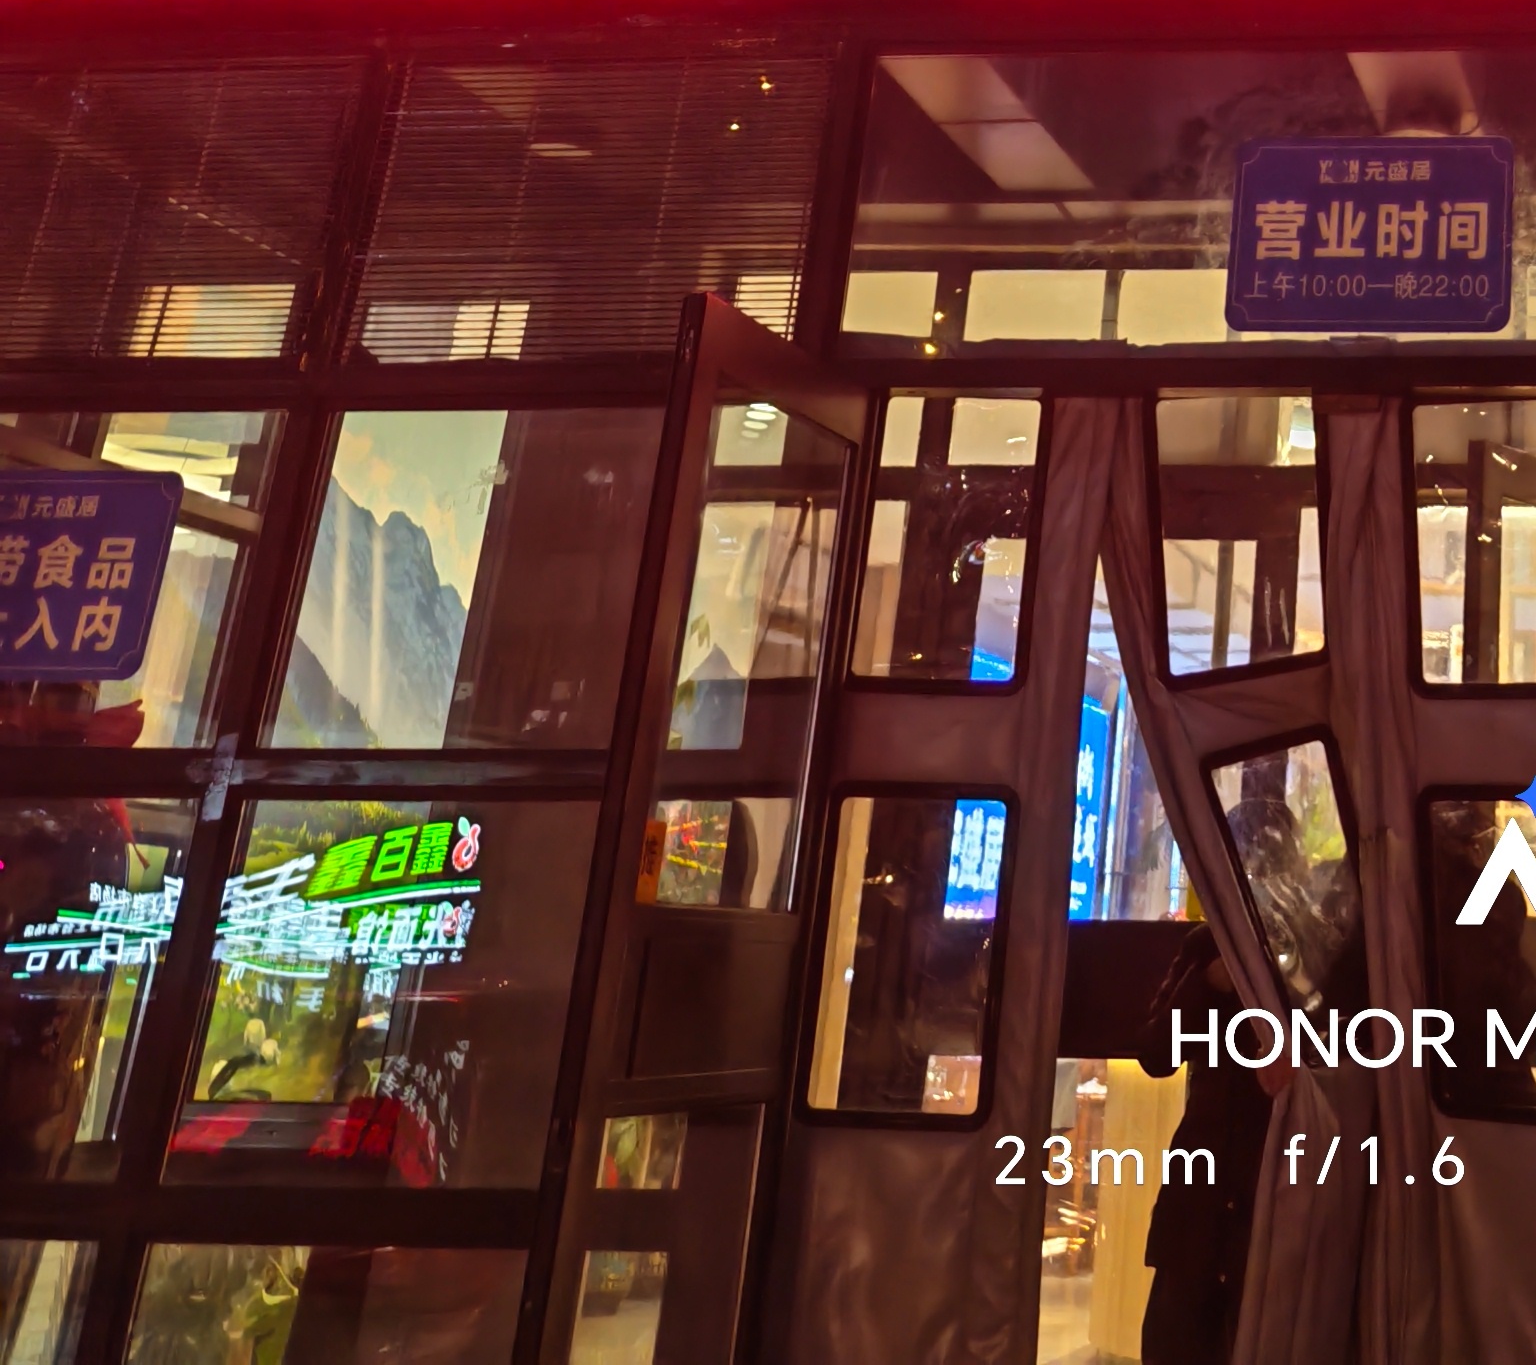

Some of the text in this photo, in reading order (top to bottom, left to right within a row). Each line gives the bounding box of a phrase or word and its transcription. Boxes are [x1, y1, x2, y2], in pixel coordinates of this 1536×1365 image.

[1363, 160, 1431, 182] 元盛居
[1255, 200, 1489, 260] 营业时间
[31, 494, 100, 519] 元盛居
